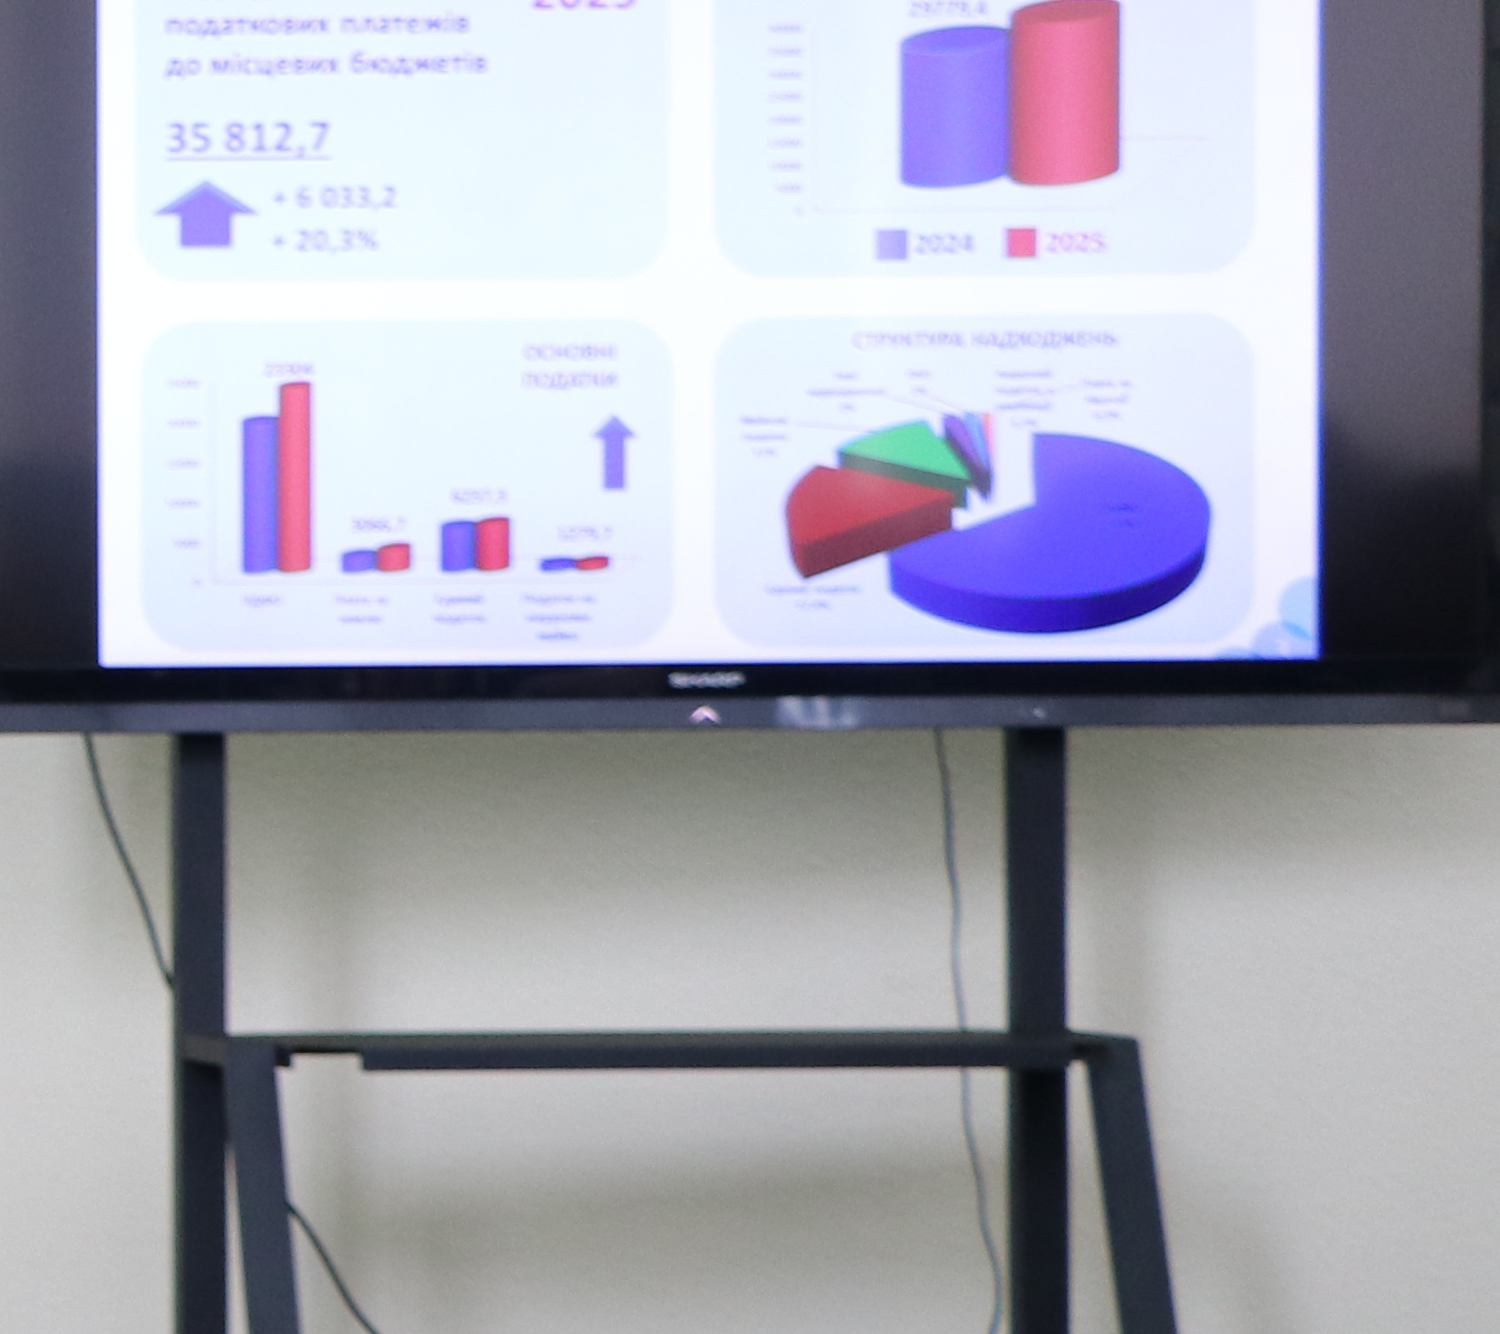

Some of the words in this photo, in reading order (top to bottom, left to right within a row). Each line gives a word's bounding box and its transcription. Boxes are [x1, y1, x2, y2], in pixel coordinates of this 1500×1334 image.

[164, 15, 330, 37] податкових
[341, 12, 470, 34] платежів
[165, 56, 202, 79] до
[211, 53, 339, 78] місцевих
[350, 51, 487, 76] бюджетів
[167, 122, 211, 153] 35
[224, 121, 330, 158] 812,7
[296, 229, 378, 253] 20,3%
[914, 233, 974, 255] 2024
[1045, 230, 1106, 253] 2025
[668, 671, 745, 688] SHARP
